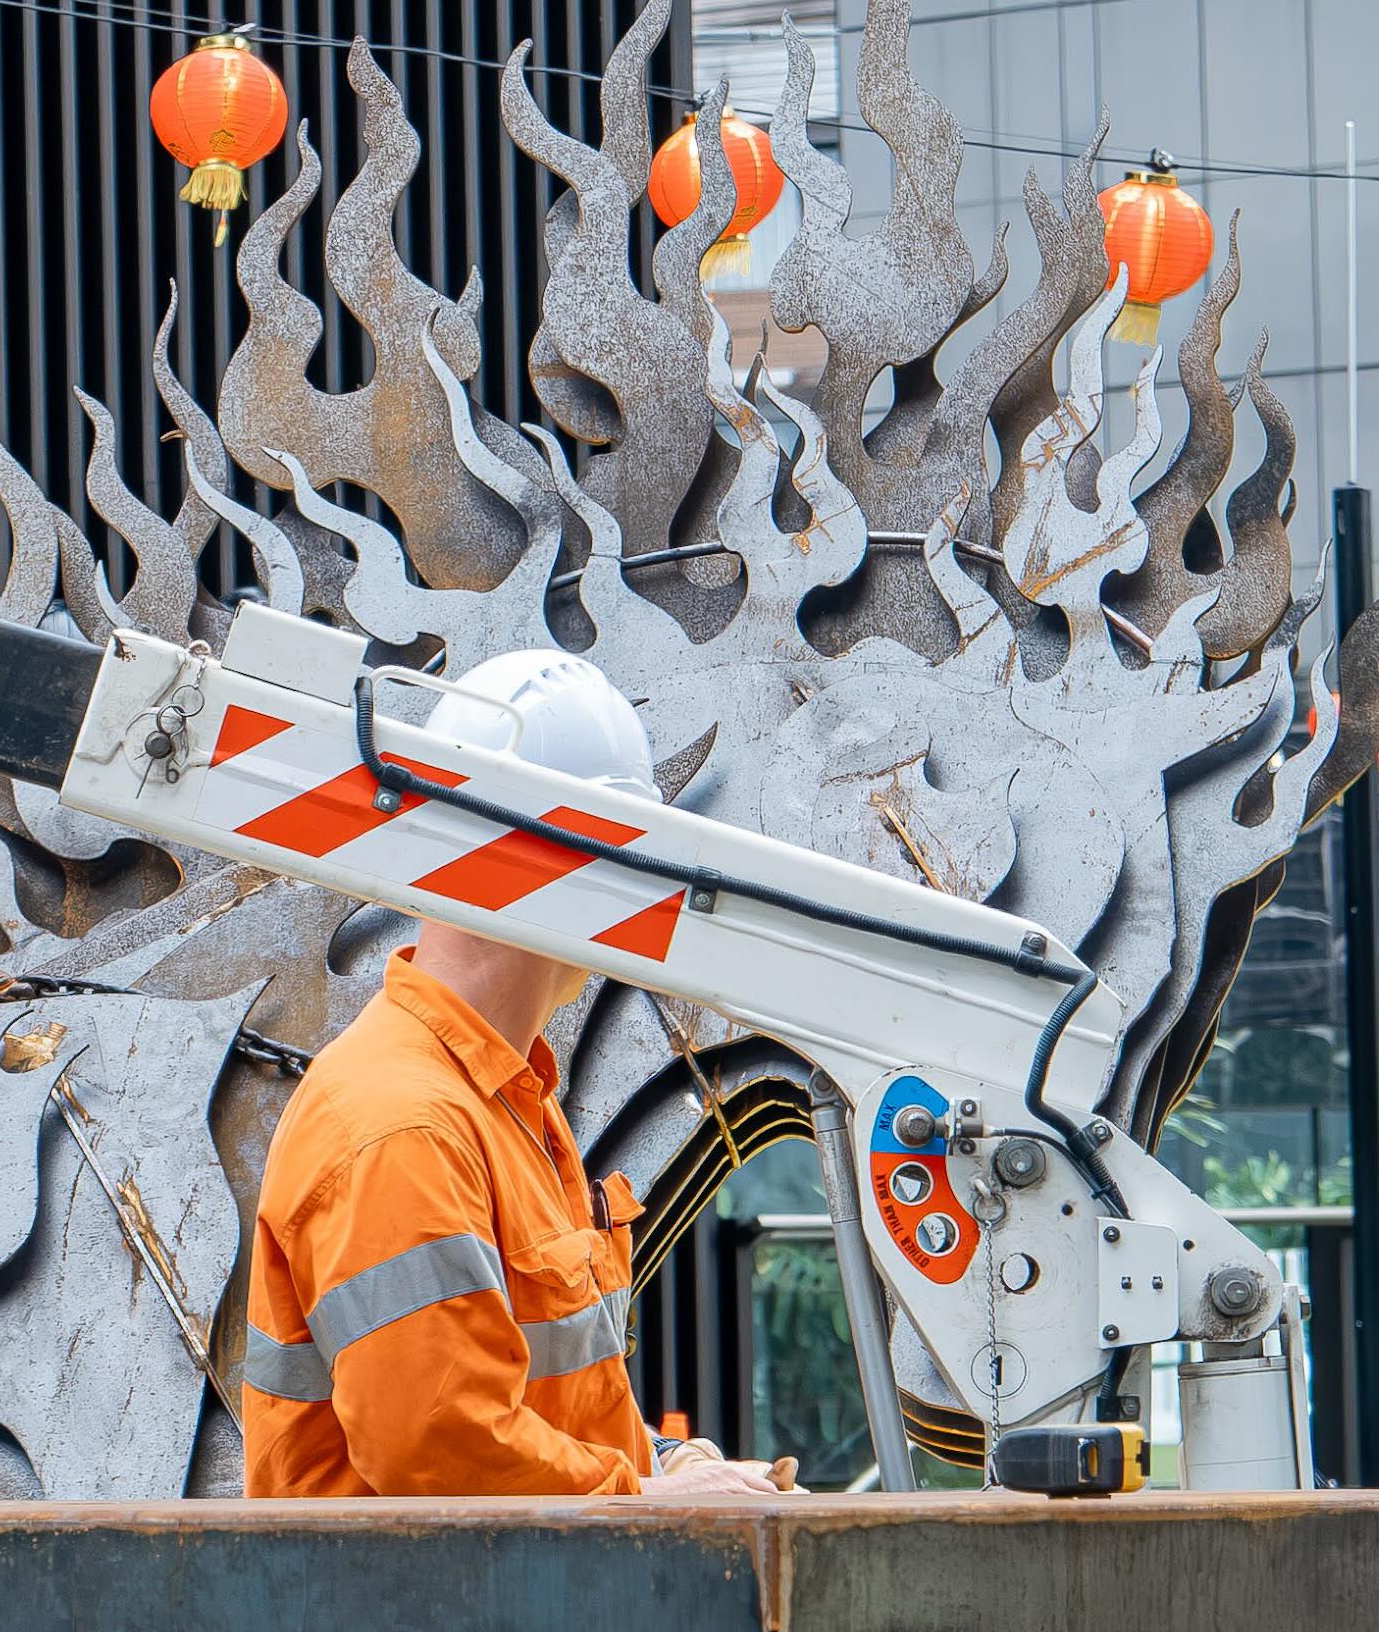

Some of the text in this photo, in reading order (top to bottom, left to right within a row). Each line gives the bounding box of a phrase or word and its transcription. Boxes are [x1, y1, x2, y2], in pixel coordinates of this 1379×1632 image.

[879, 1103, 896, 1132] MAX
[876, 1174, 930, 1268] OTHER THAN MAX
